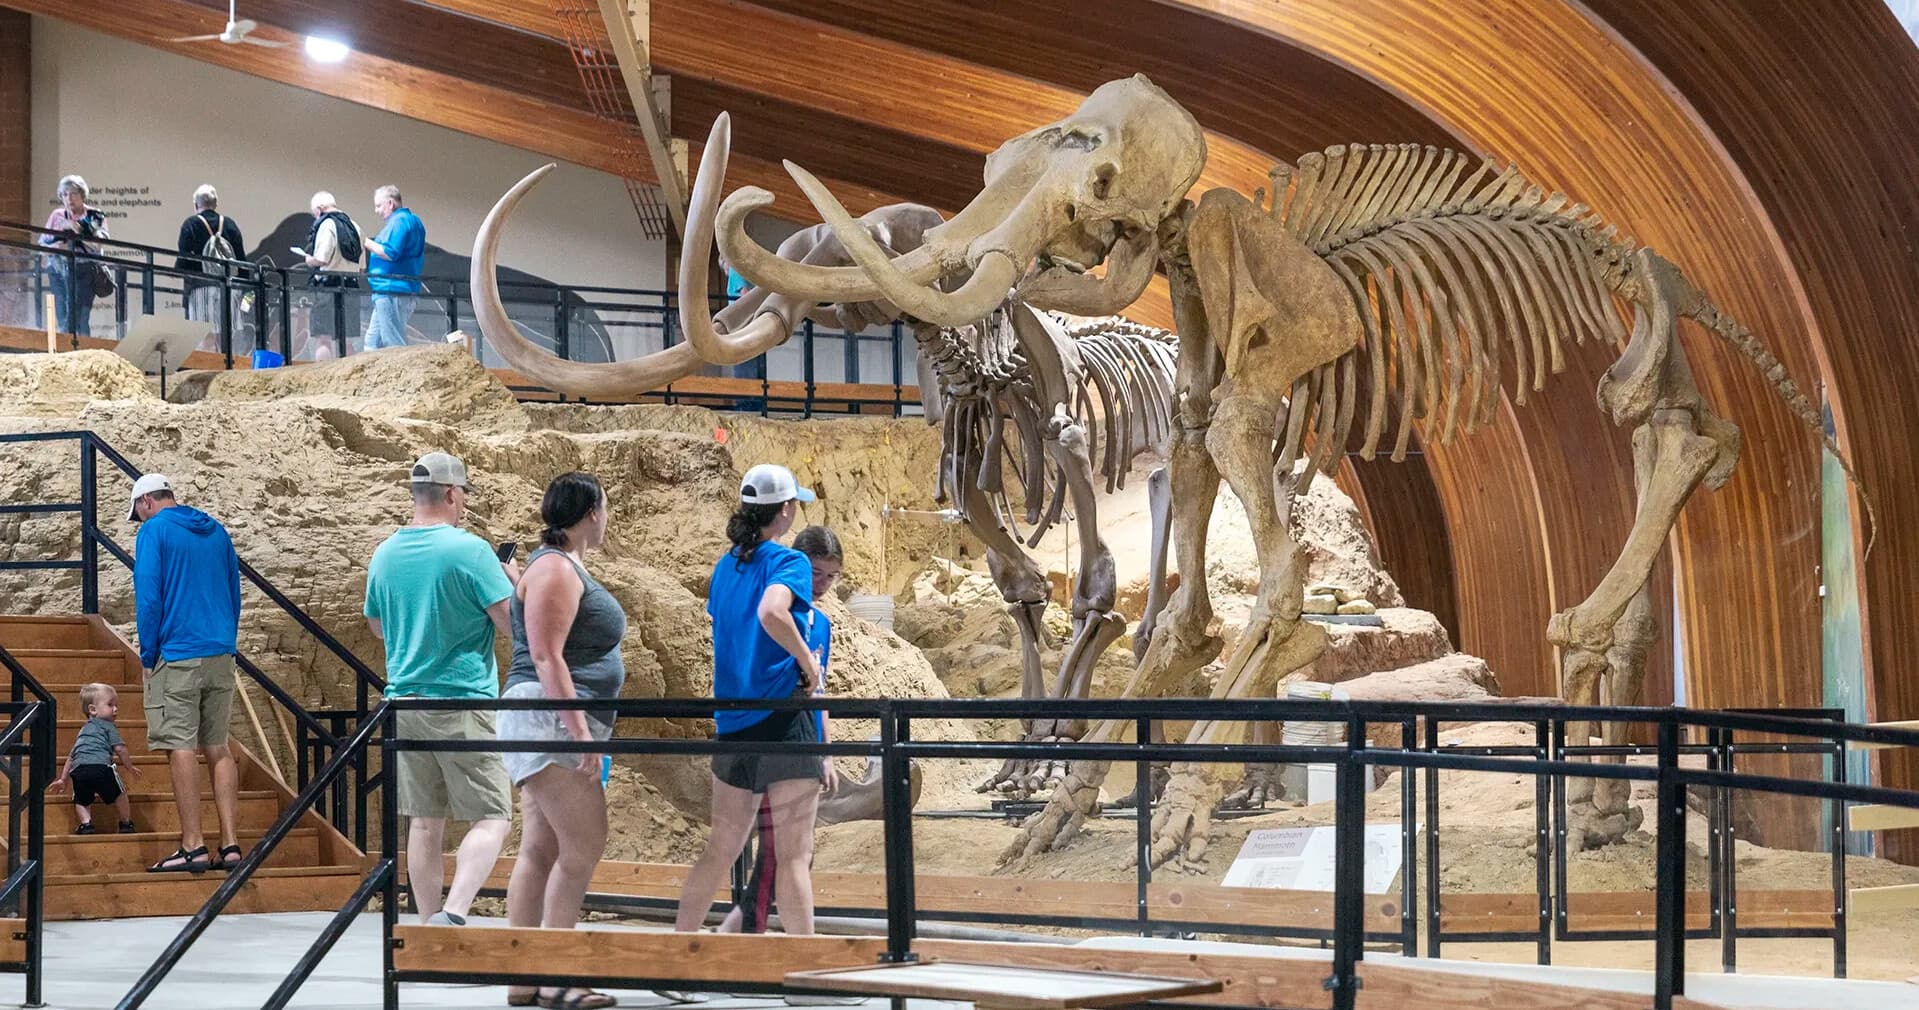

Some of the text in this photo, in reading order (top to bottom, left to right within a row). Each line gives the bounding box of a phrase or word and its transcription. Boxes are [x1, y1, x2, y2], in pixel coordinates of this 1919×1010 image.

[105, 186, 138, 196] heights
[140, 186, 150, 194] of
[101, 198, 117, 206] and
[118, 198, 161, 208] elephants
